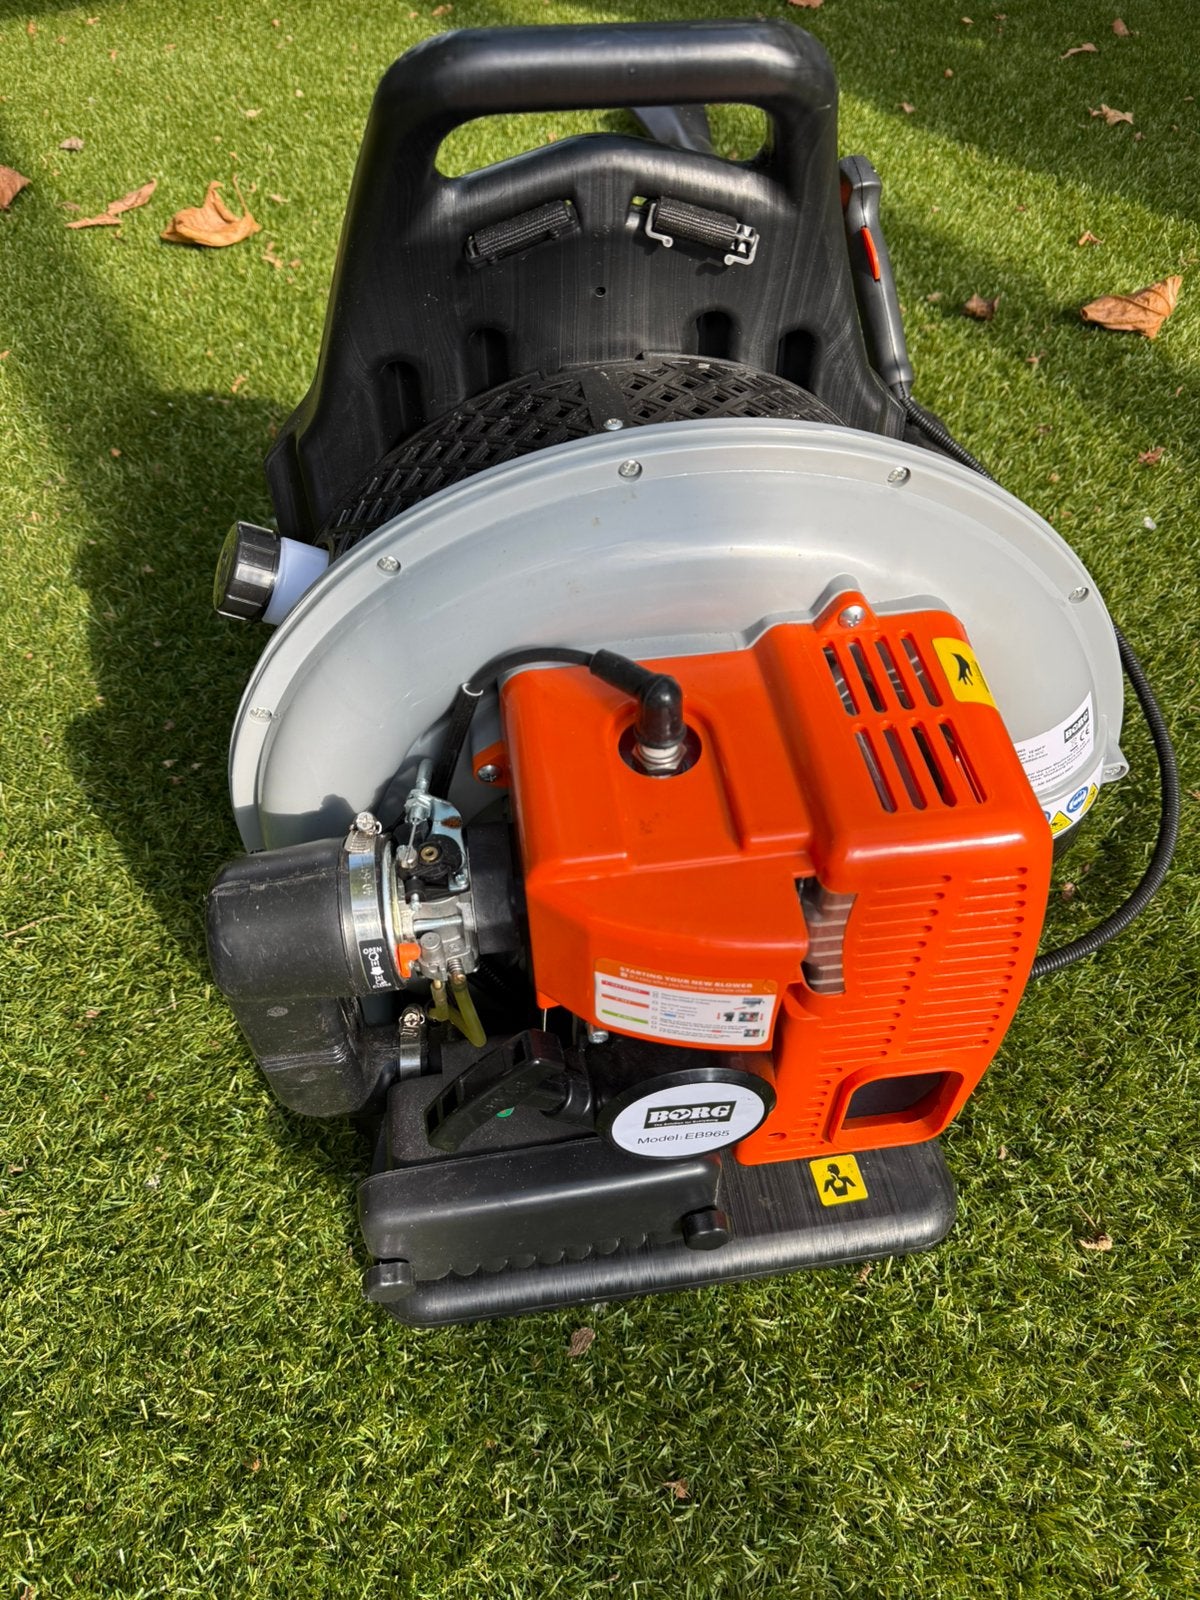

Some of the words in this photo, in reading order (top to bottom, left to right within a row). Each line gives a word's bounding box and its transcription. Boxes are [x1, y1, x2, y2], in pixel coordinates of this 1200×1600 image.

[363, 946, 382, 955] OPEN
[619, 966, 663, 980] STARTING
[664, 976, 690, 984] YOUR
[691, 979, 713, 987] NEW
[648, 1105, 731, 1124] BORG
